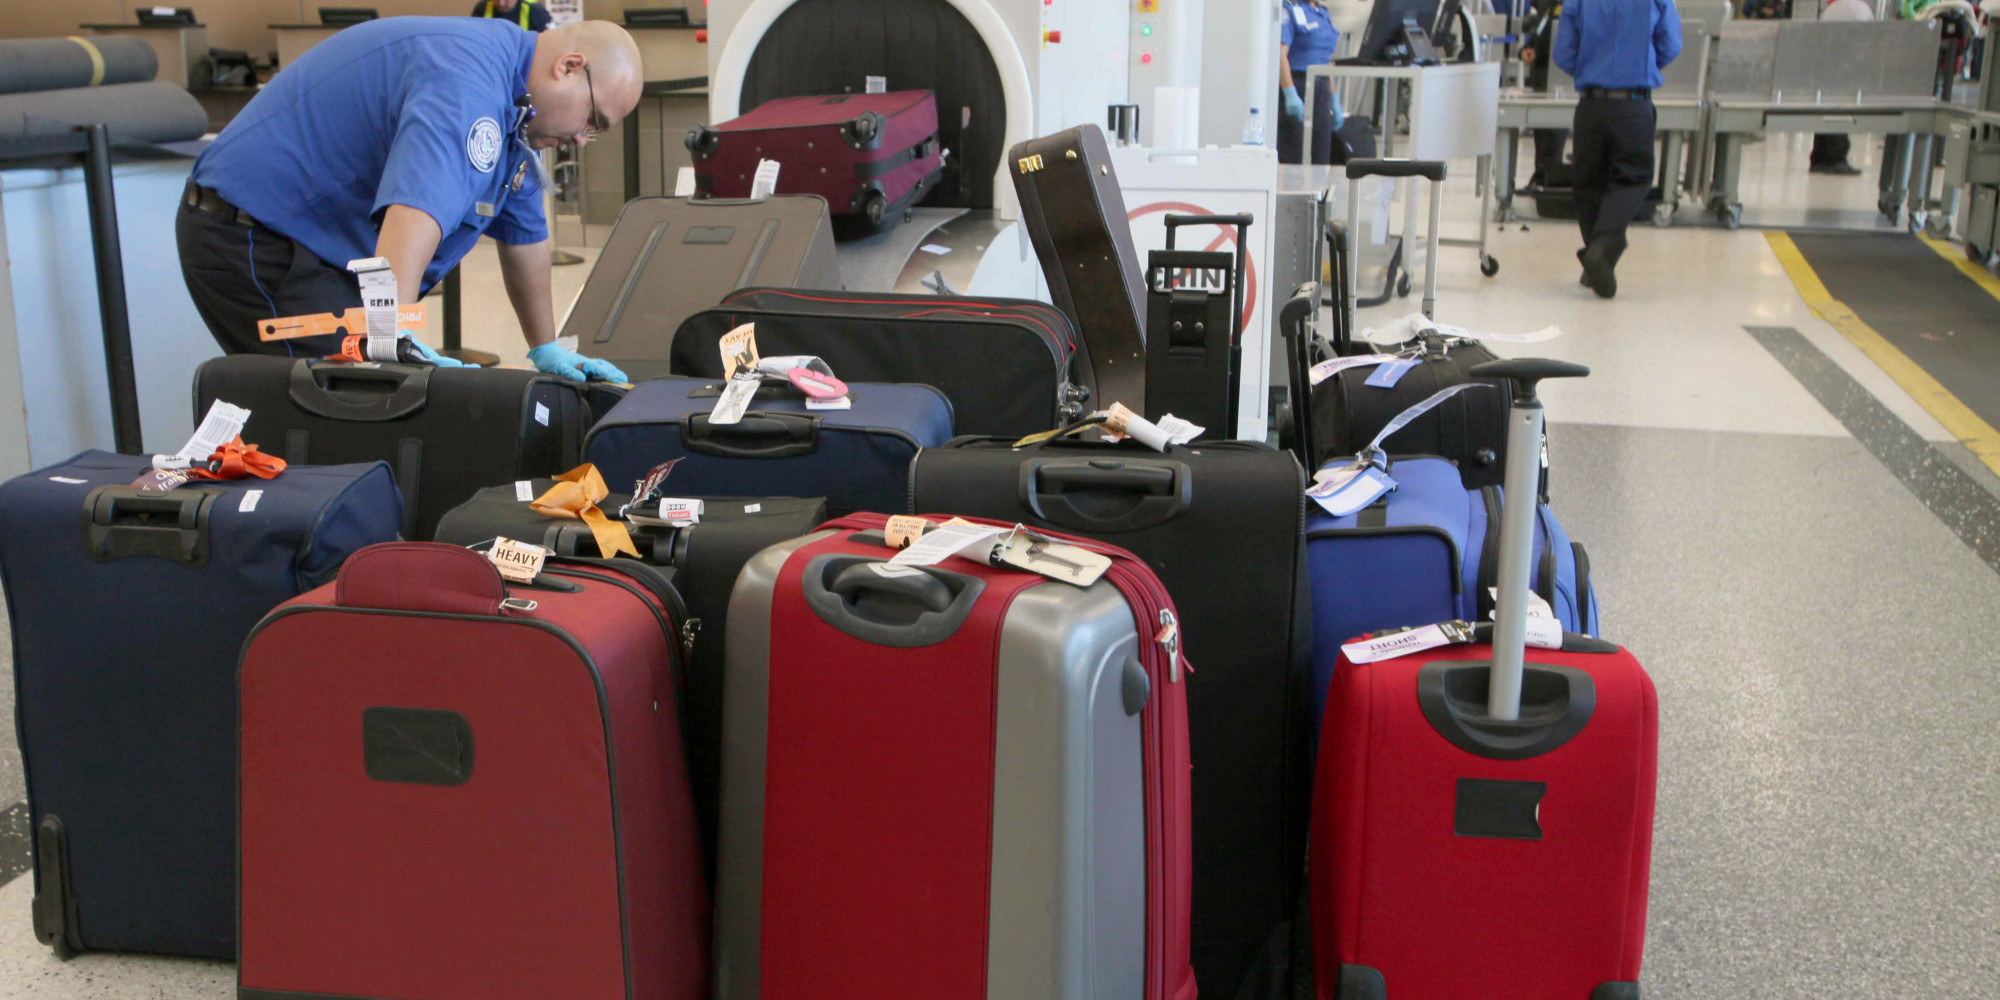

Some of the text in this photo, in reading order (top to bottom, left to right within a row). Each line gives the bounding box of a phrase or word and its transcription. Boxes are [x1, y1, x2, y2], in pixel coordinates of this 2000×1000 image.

[1145, 267, 1236, 288] CHIN
[397, 311, 422, 322] PRIO
[496, 547, 538, 566] HEAVY
[1370, 635, 1417, 650] SHORT
